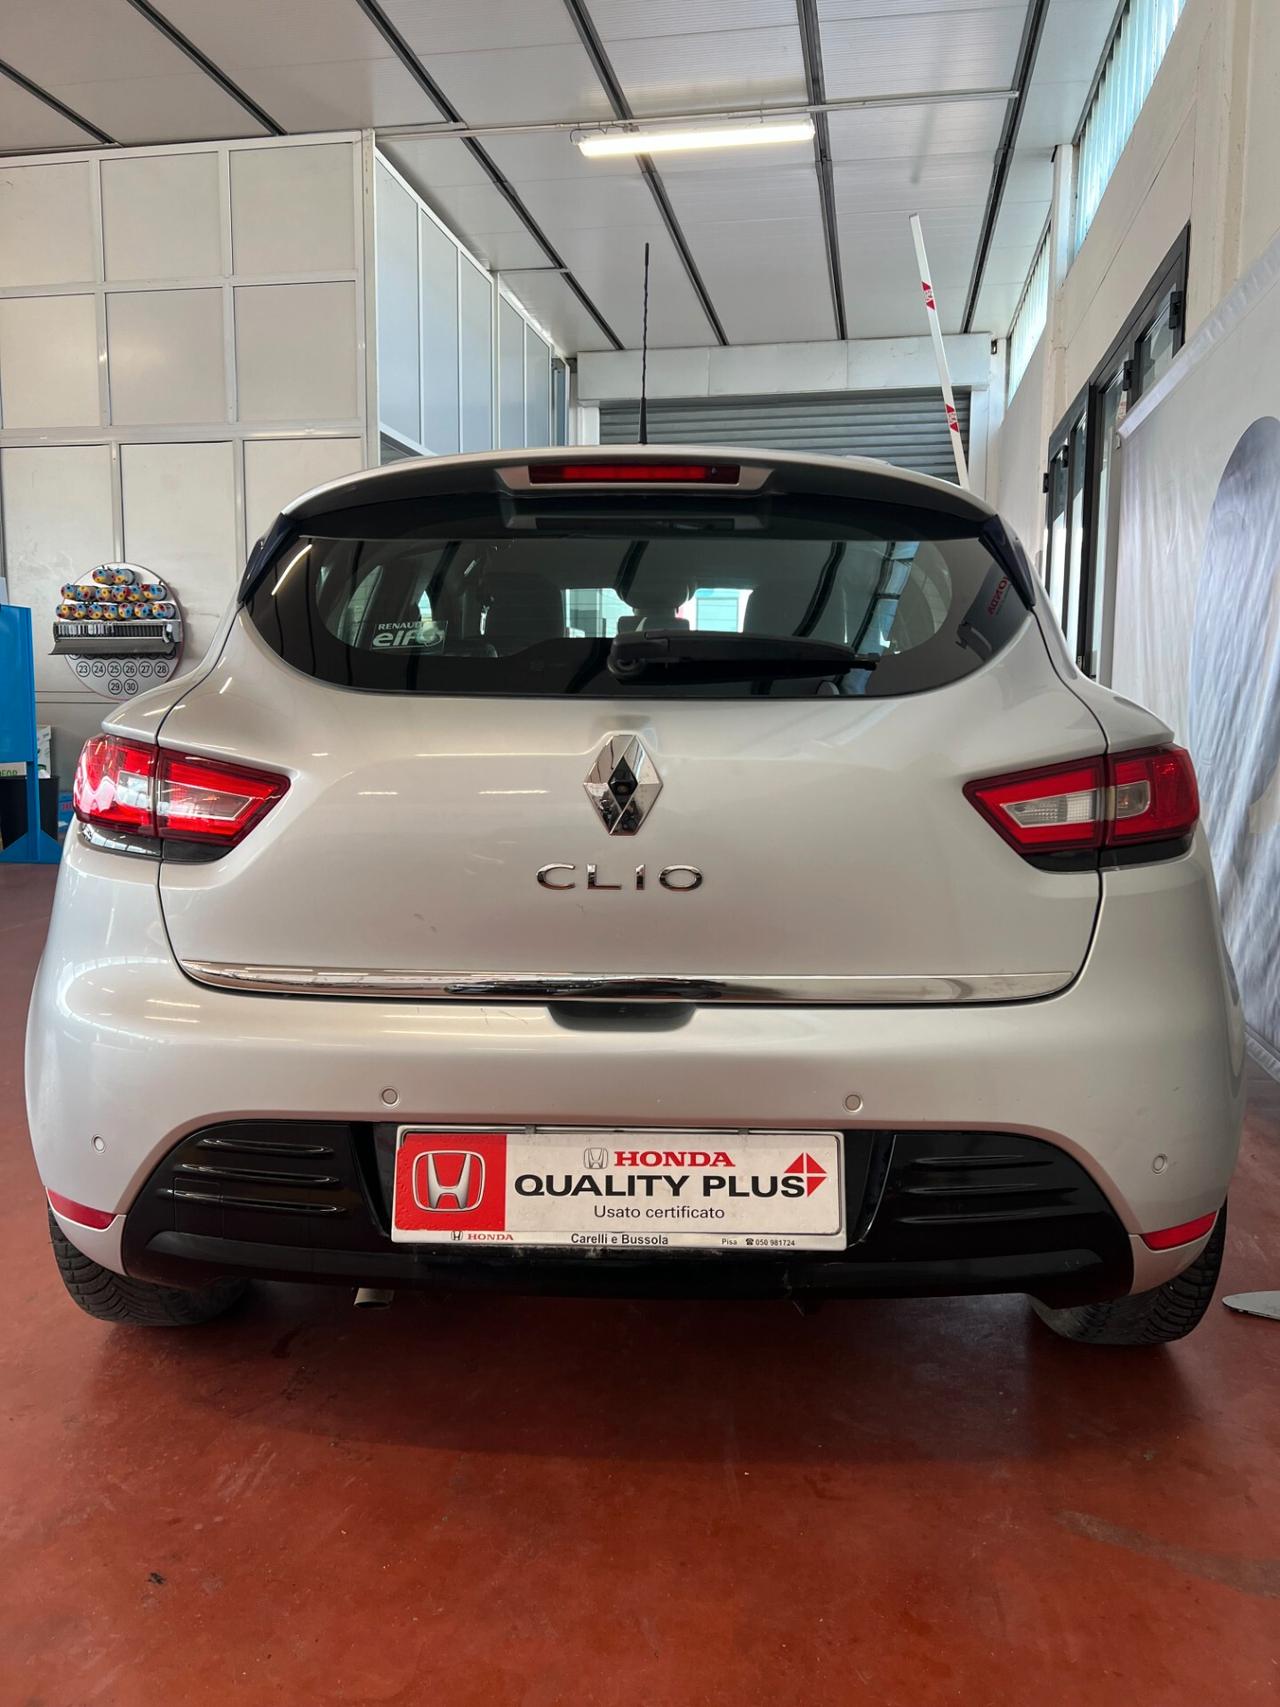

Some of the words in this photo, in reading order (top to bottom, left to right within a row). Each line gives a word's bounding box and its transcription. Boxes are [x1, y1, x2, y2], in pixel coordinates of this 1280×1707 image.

[372, 630, 418, 647] elf
[79, 665, 88, 674] 23
[94, 665, 104, 674] 24
[110, 665, 120, 674] 25
[126, 665, 135, 674] 26
[141, 665, 150, 674] 27
[157, 665, 167, 674] 28
[110, 682, 120, 691] 29
[126, 682, 136, 691] 30
[536, 863, 704, 892] CLIO
[613, 1151, 736, 1168] HONDA
[514, 1174, 690, 1198] QUALITY
[703, 1175, 805, 1198] PLUS
[594, 1205, 641, 1219] Usato
[645, 1205, 725, 1219] certificato
[467, 1233, 514, 1242] HONDA
[571, 1233, 608, 1245] Carelli
[611, 1236, 618, 1245] e
[621, 1234, 669, 1246] Bussola
[721, 1238, 738, 1246] Pisa
[755, 1239, 769, 1247] 050
[770, 1239, 795, 1247] 981724
